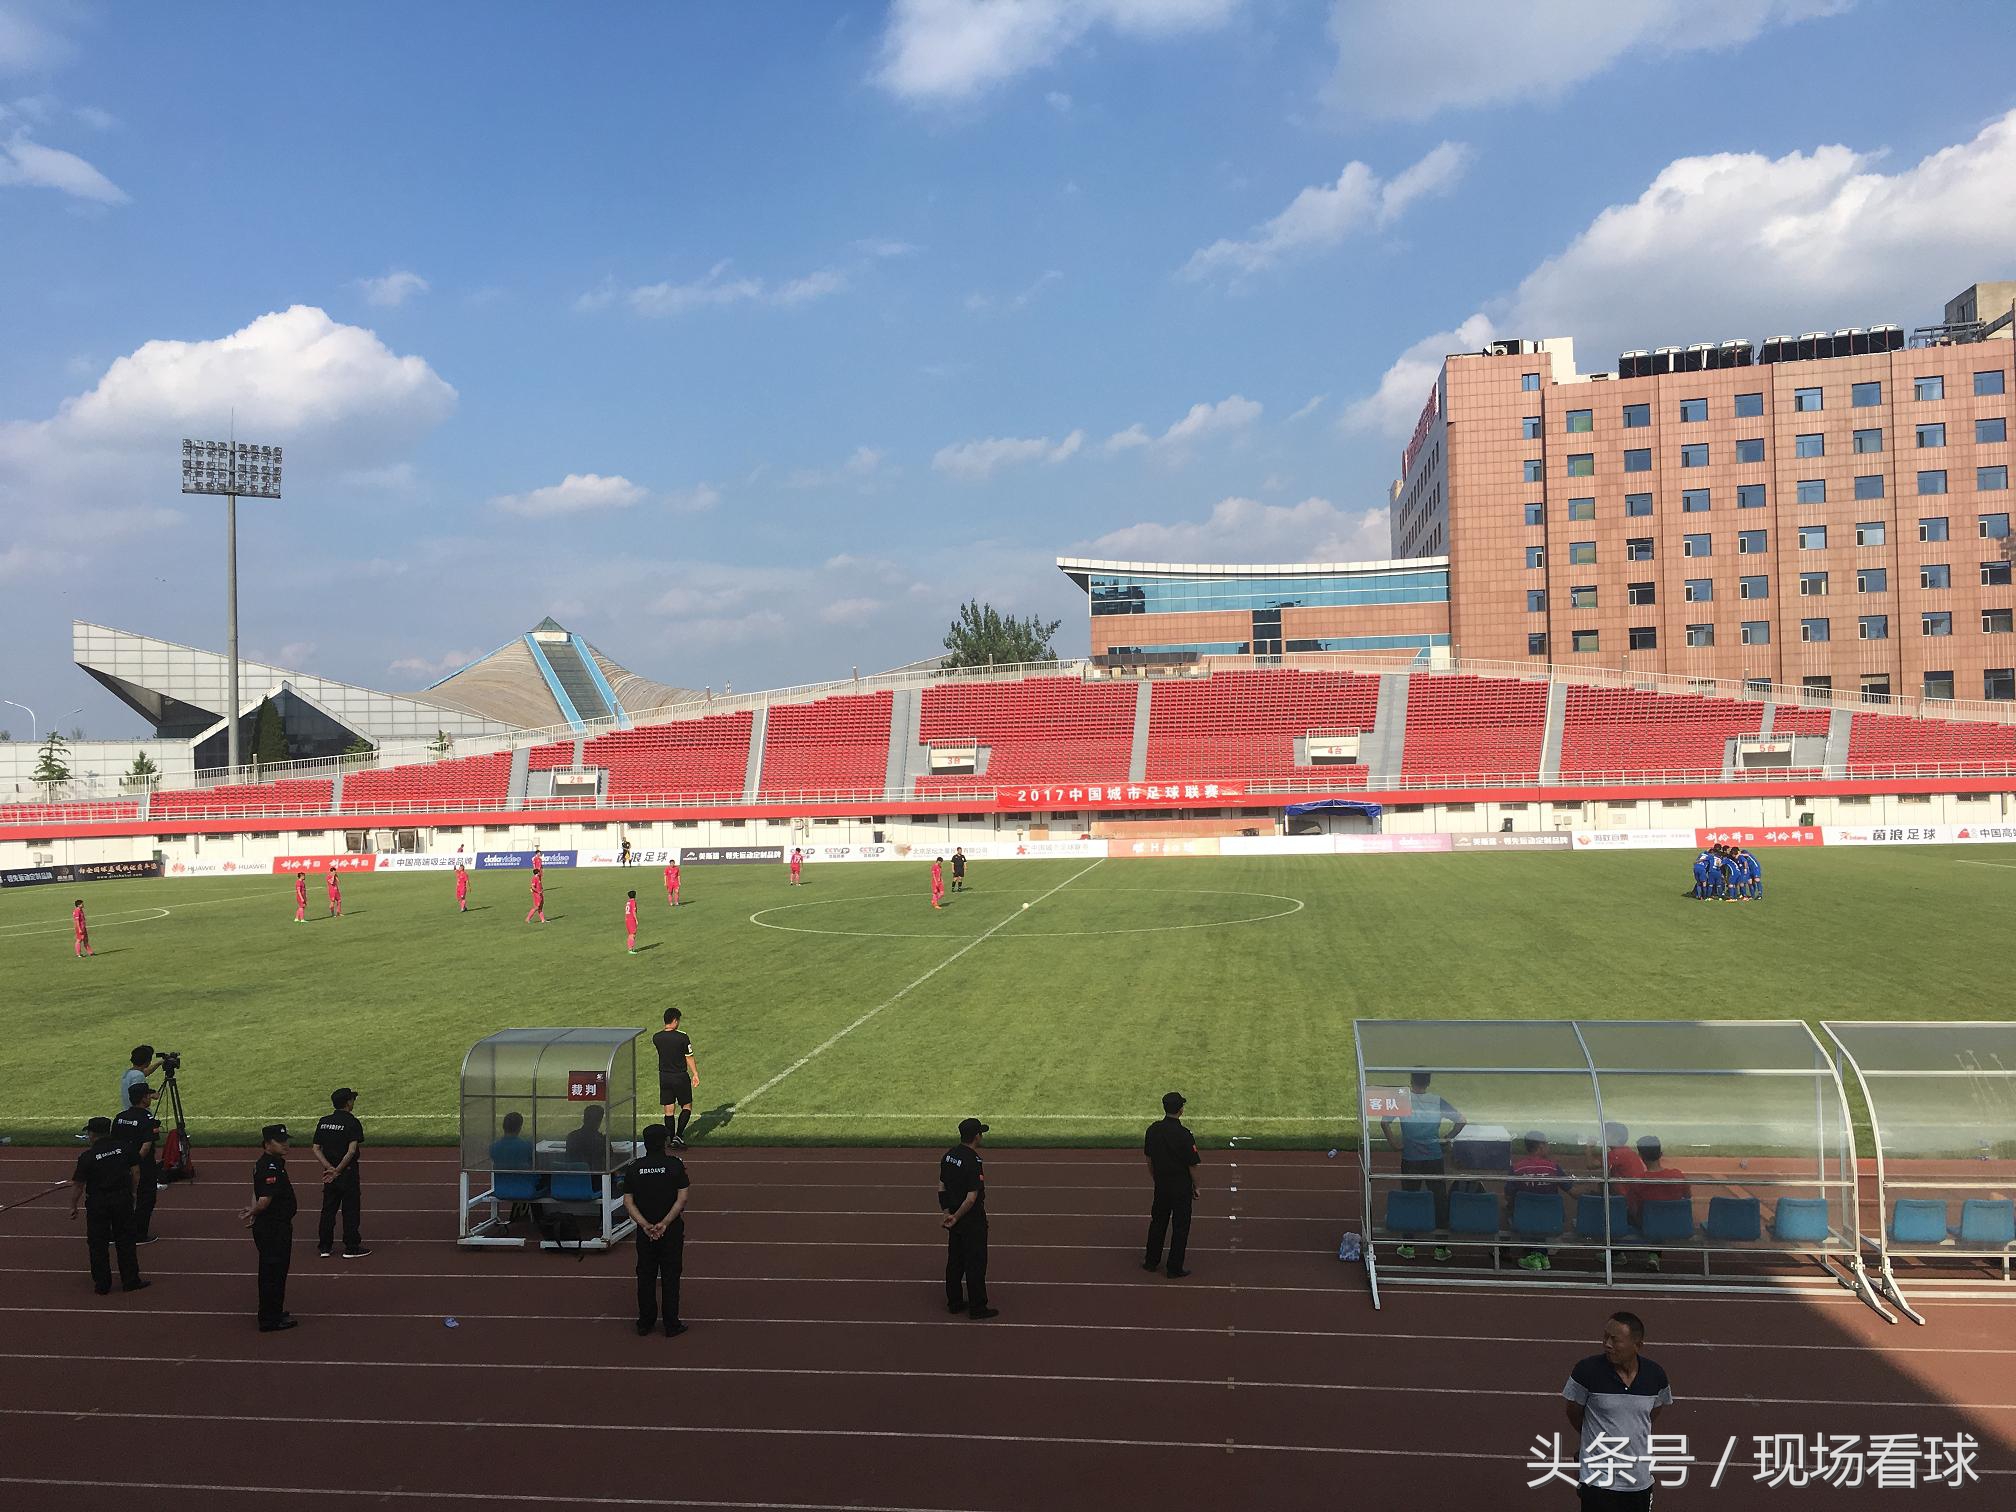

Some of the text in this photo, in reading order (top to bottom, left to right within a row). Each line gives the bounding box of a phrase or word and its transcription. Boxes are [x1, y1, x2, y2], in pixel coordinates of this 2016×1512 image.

[1872, 828, 1936, 841] 茵浪足球
[571, 1083, 597, 1096] 裁判
[1369, 1098, 1400, 1111] 客队
